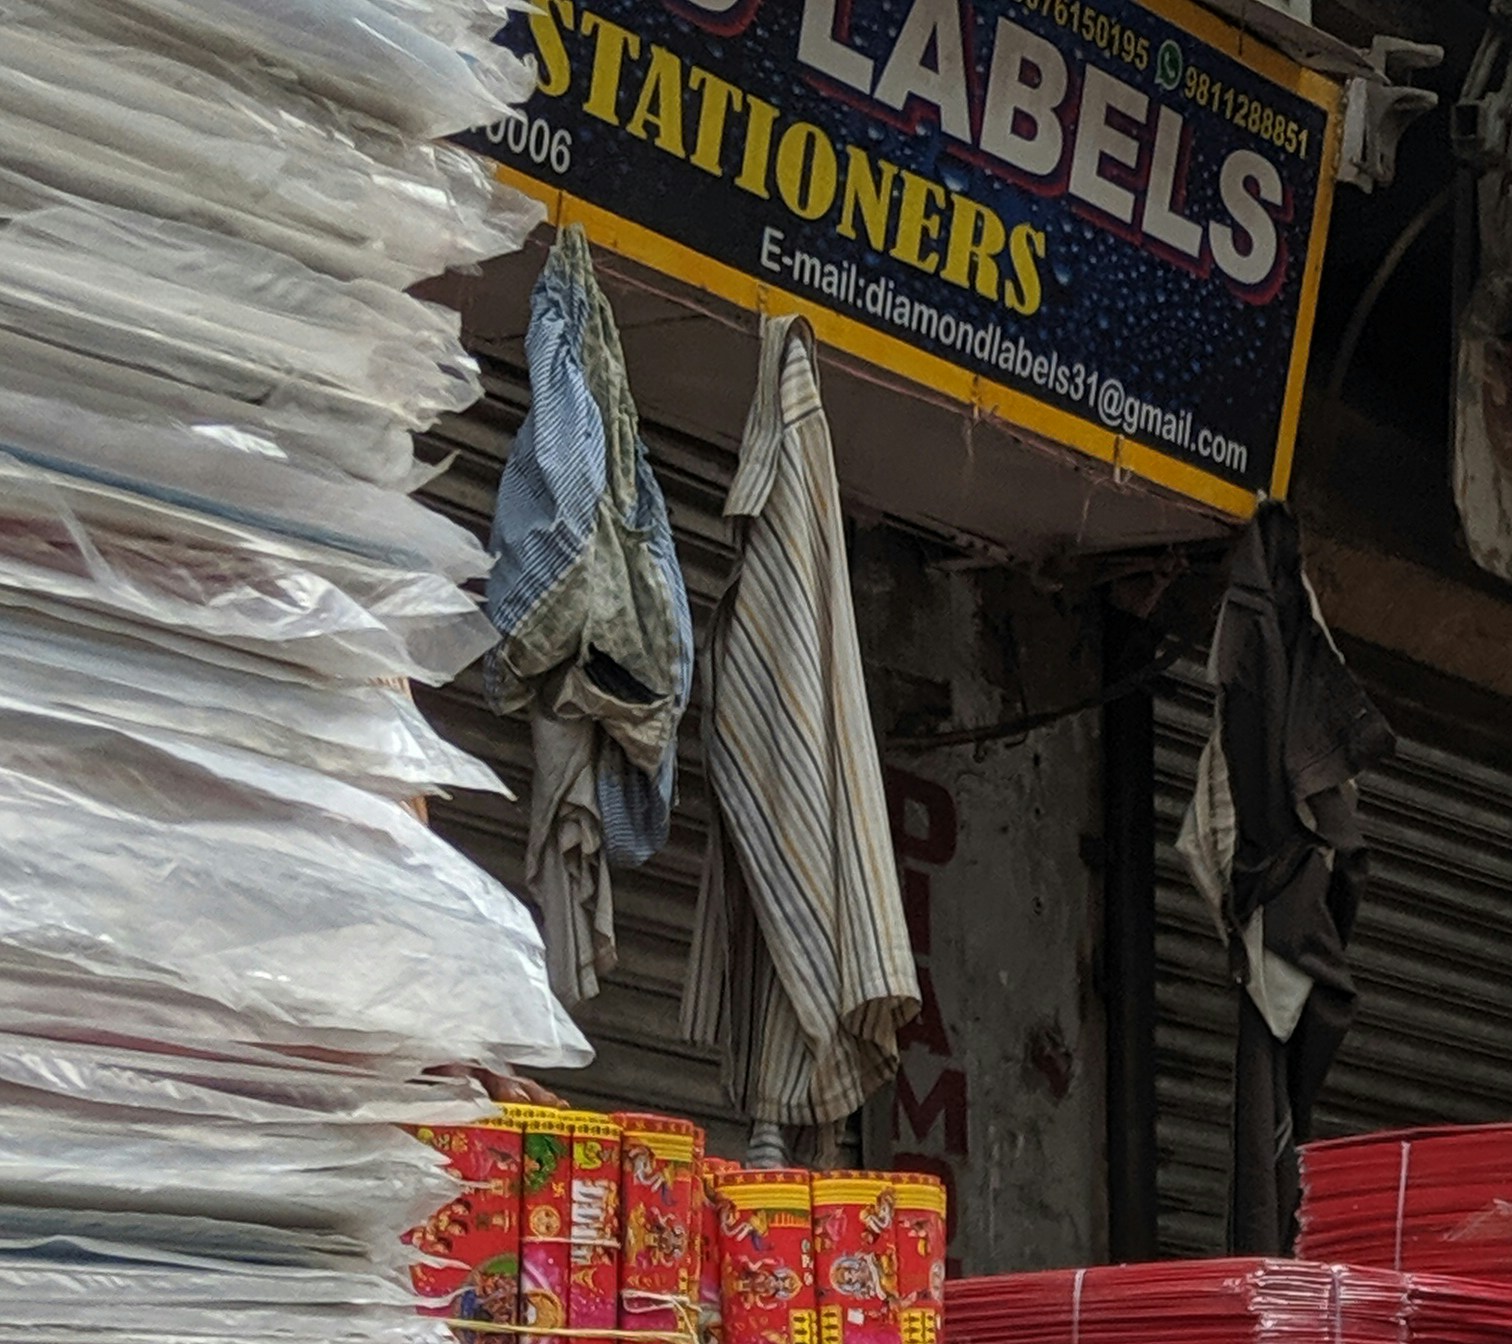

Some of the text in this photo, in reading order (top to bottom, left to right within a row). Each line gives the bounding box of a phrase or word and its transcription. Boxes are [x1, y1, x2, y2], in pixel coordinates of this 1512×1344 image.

[529, 0, 1047, 316] STATIONERS
[797, 0, 1285, 287] LABELS
[1024, 0, 1310, 160] 76150195 9811288851
[759, 228, 1249, 474] E-mail:diamondlabels31@gmail.com
